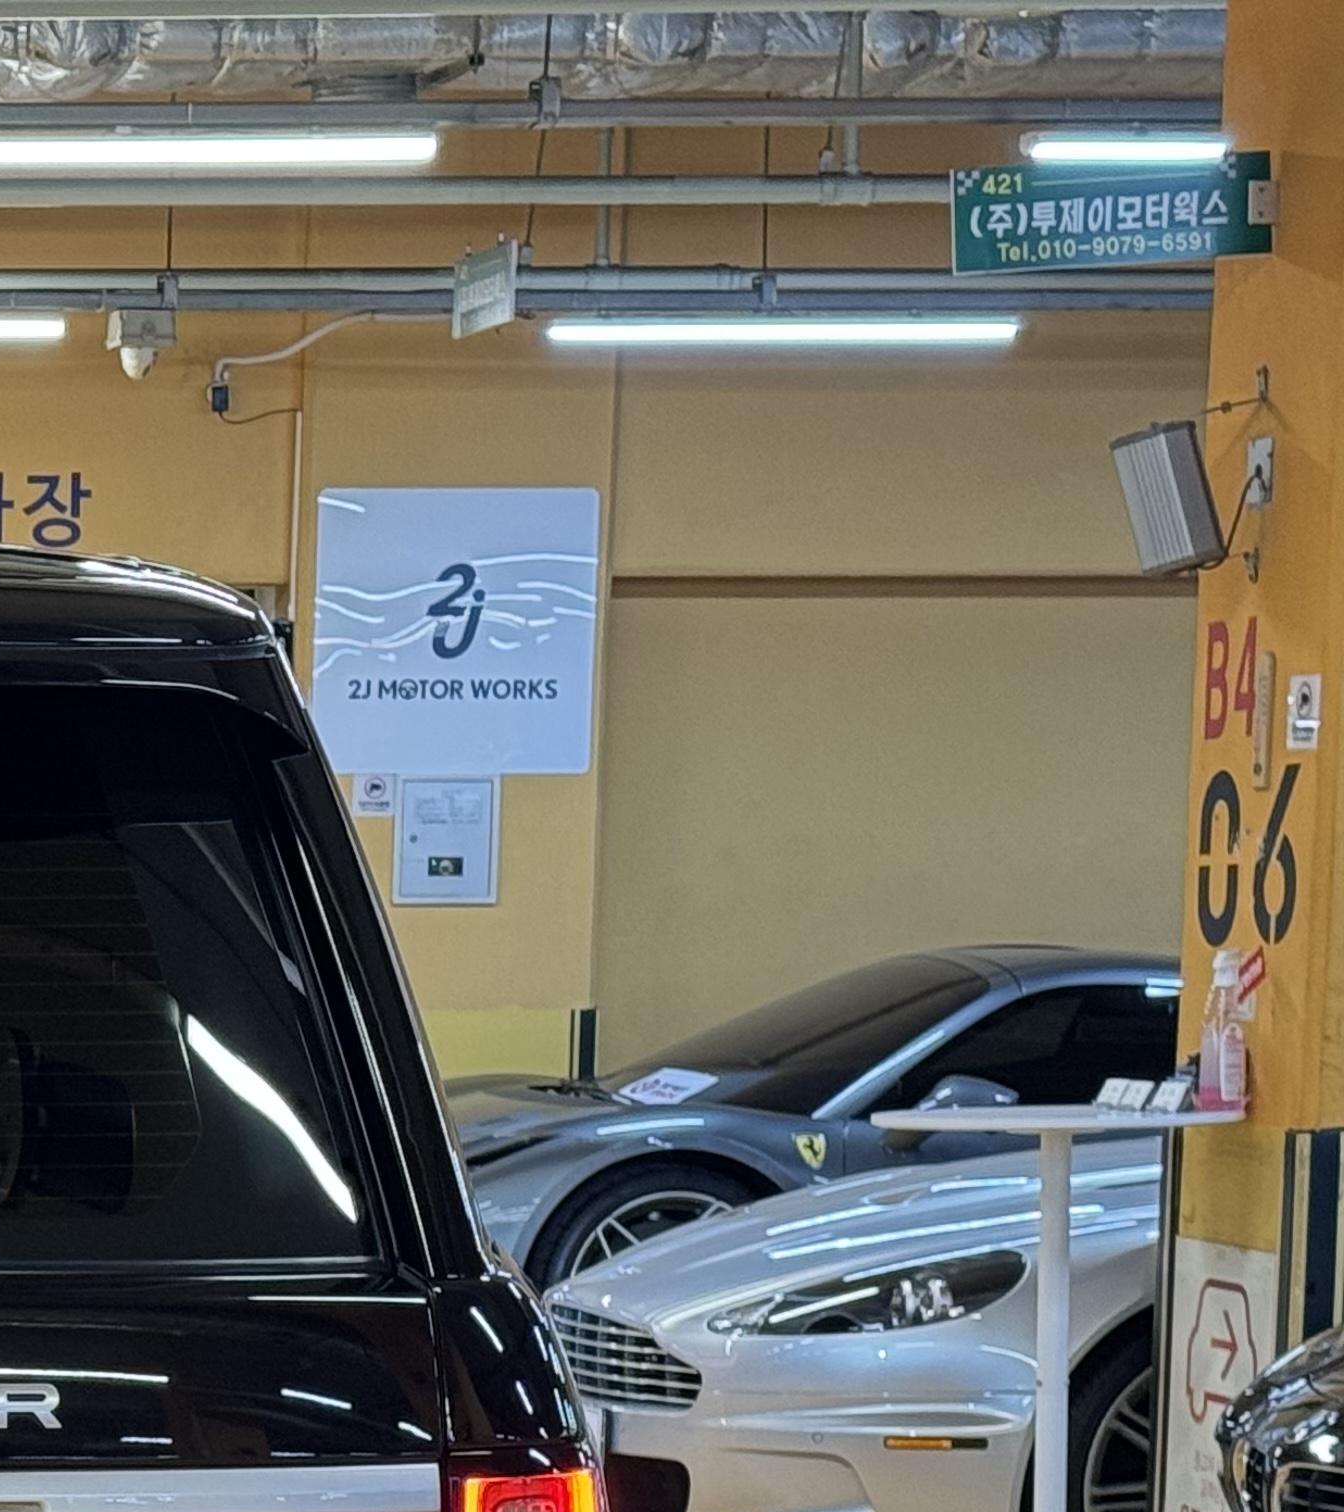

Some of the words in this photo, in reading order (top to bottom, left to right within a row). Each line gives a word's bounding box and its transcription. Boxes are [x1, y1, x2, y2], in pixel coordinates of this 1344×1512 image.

[981, 172, 1023, 195] 421
[970, 190, 1229, 239] (주)투제이모터웍스
[997, 231, 1212, 263] Tel.010-9079-6591
[348, 679, 371, 700] 2J
[378, 678, 463, 701] MOTOR
[470, 678, 558, 700] WORKS
[1204, 616, 1257, 740] B4
[1198, 763, 1297, 946] 06
